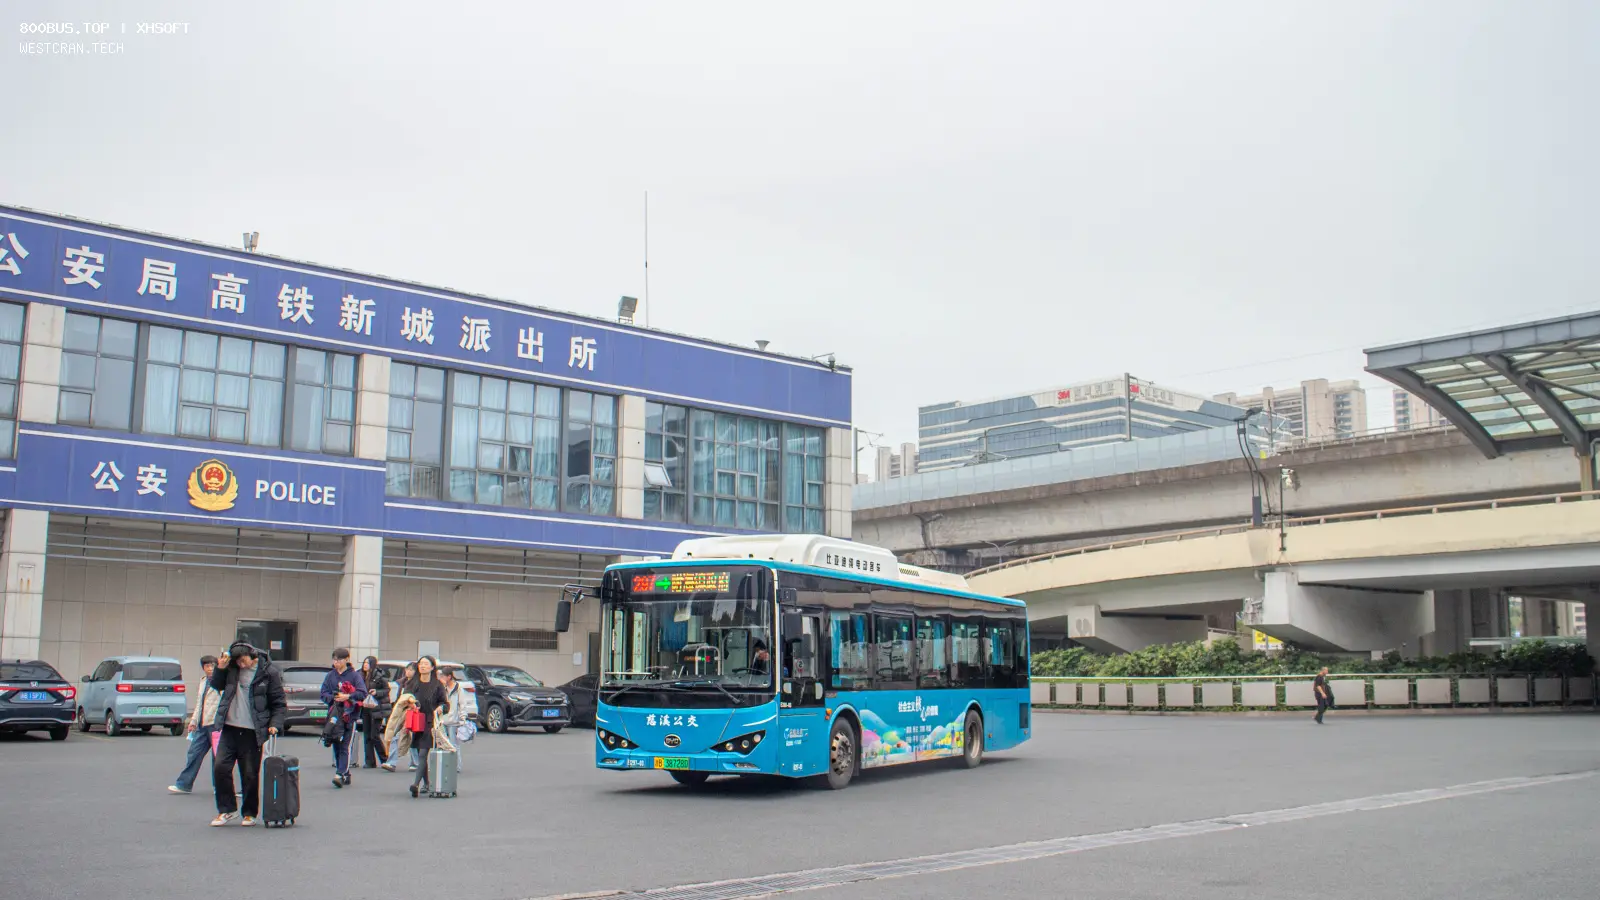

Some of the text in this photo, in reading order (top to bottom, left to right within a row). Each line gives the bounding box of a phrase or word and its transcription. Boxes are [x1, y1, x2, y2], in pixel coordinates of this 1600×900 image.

[0, 232, 598, 372] 公安局高铁新城派出所
[1058, 390, 1071, 400] 3M
[91, 461, 336, 506] 公安 POLICE
[646, 713, 698, 727] 慈溪公交
